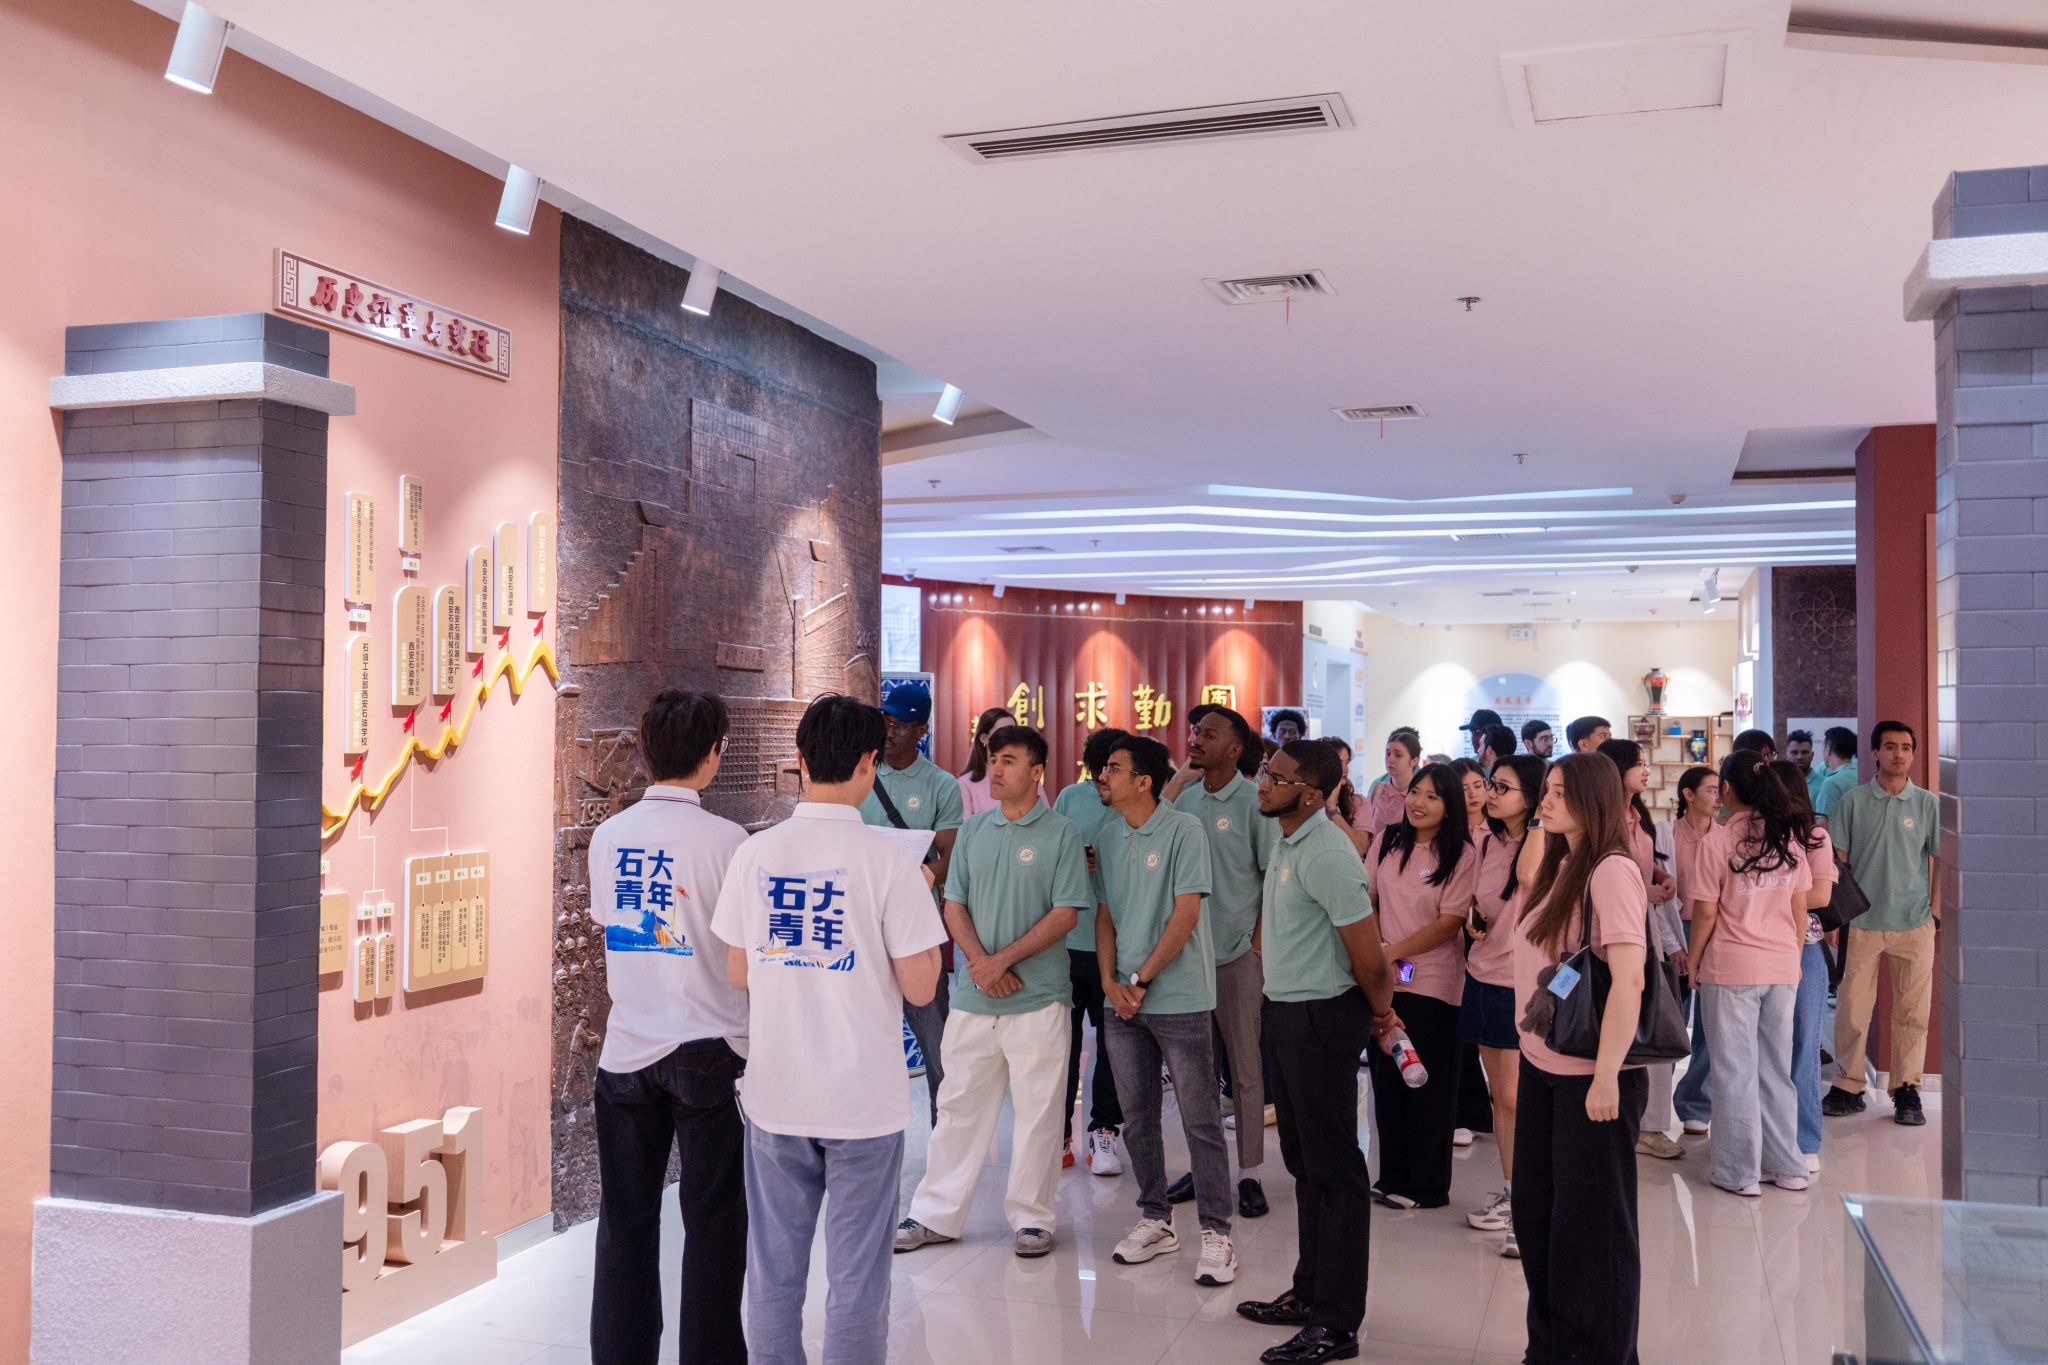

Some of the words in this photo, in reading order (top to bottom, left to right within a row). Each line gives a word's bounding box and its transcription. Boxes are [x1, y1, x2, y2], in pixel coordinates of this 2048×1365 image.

[581, 802, 610, 824] 1958
[614, 848, 674, 881] 石大
[614, 880, 674, 912] 青年
[767, 876, 845, 915] 石大
[769, 913, 844, 950] 青年
[317, 1106, 483, 1290] 951
